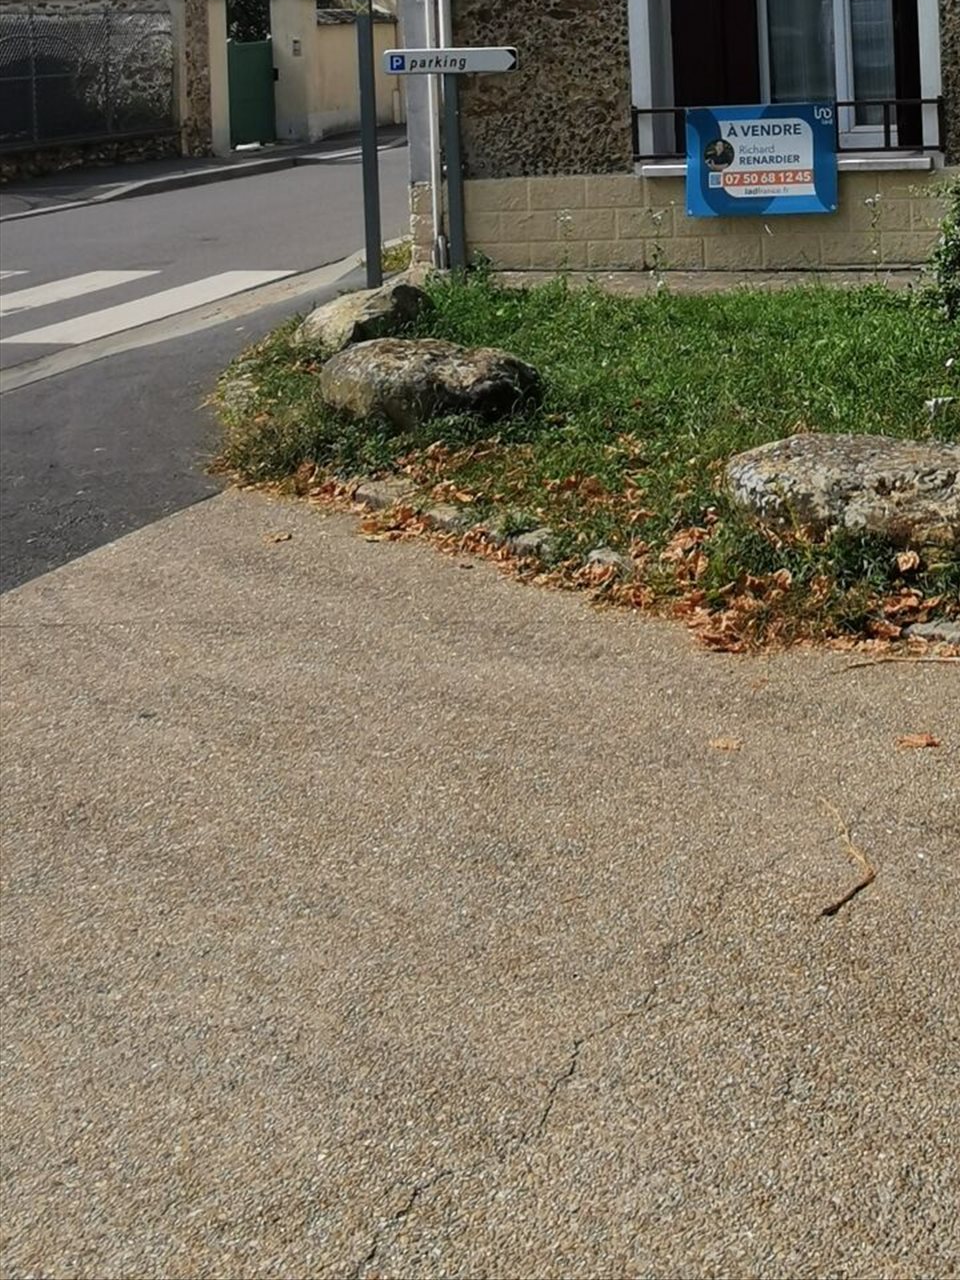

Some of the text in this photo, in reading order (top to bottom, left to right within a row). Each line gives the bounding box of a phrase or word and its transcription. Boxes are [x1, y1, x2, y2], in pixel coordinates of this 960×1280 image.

[410, 56, 466, 70] parking
[727, 123, 802, 137] À VENDRE
[739, 144, 775, 155] Richard
[739, 155, 800, 165] RENARDIER
[725, 171, 811, 185] 07 50 68 12 45
